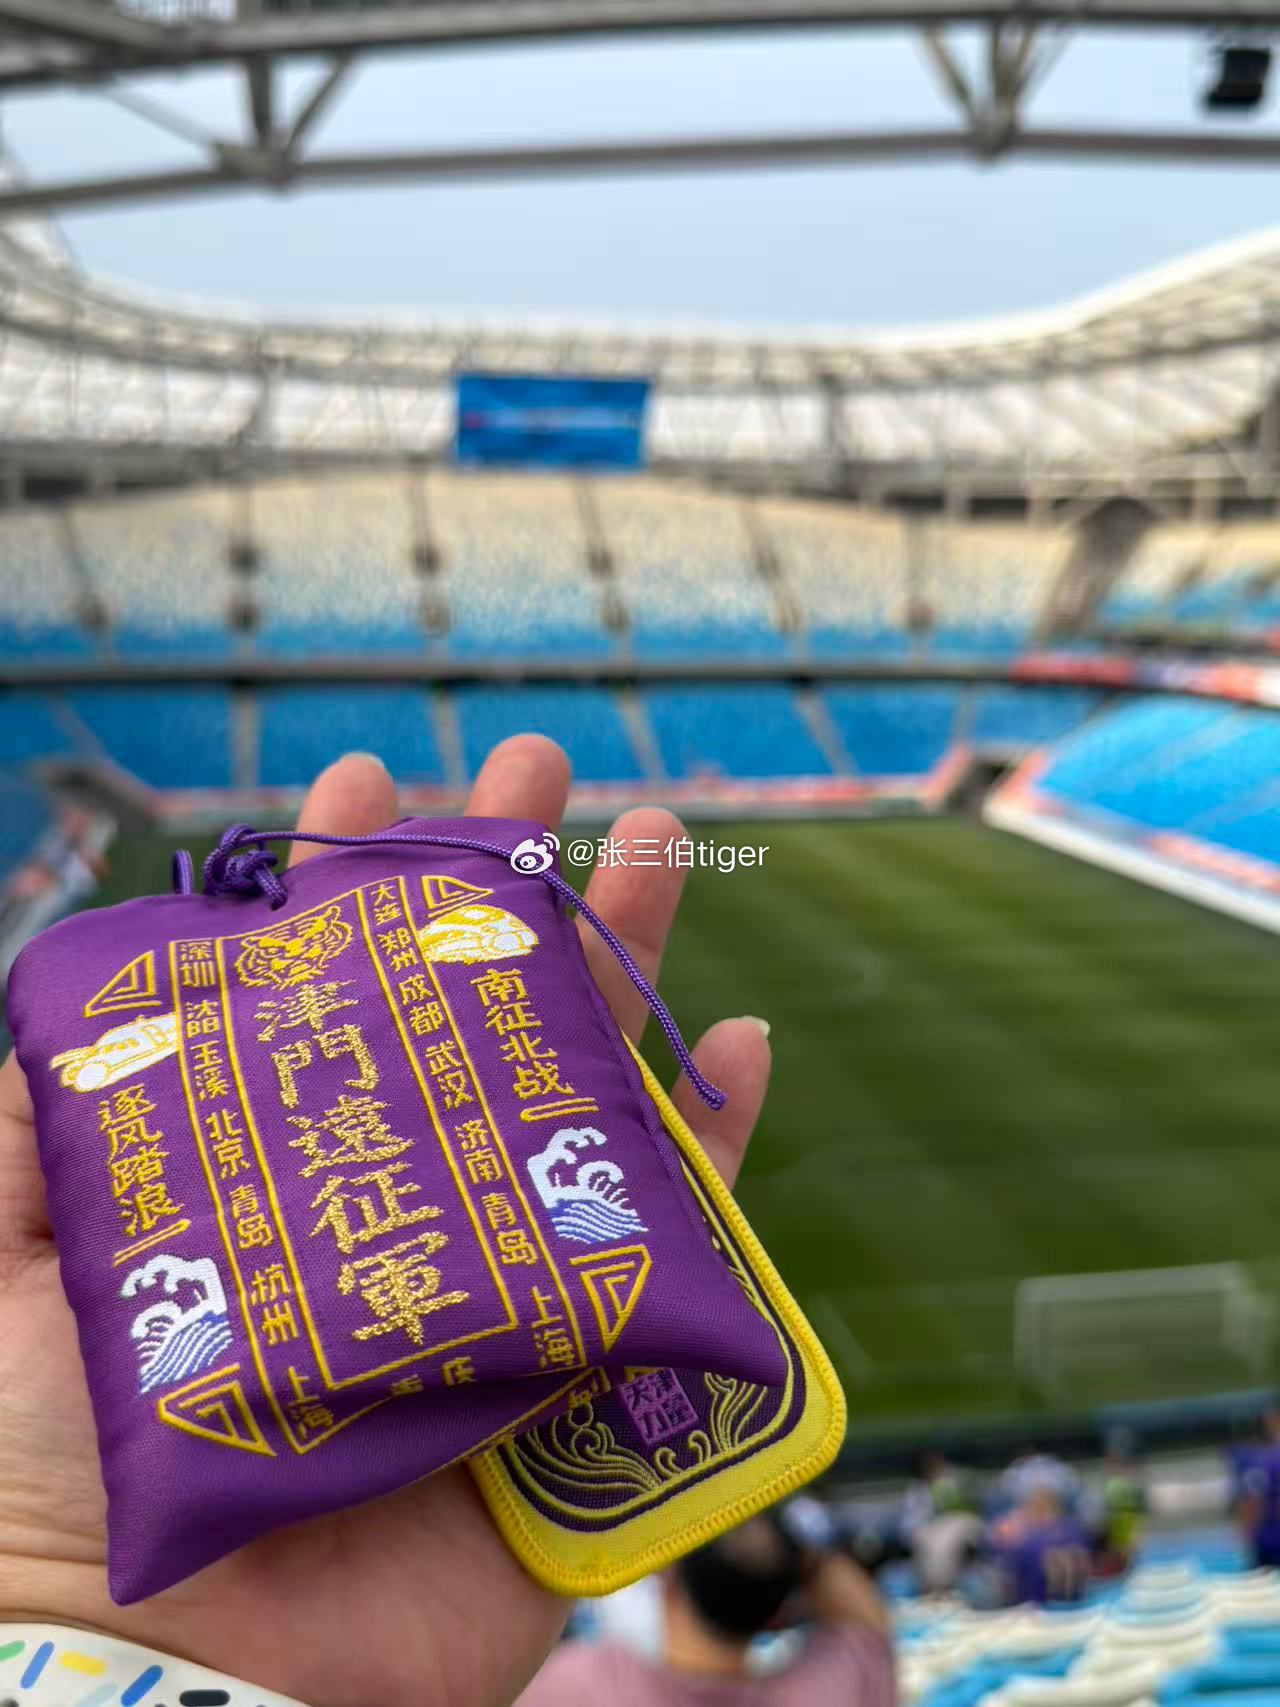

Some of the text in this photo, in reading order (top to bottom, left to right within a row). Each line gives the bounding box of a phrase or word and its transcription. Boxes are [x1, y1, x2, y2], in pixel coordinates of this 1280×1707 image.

[180, 941, 216, 988] 深圳
[470, 968, 575, 1100] 南征北战
[98, 1083, 185, 1237] 逐风踏浪
[205, 1109, 250, 1179] 北京
[377, 927, 418, 972] 郑州
[398, 973, 444, 1036] 成都
[425, 1040, 474, 1110] 武汉
[454, 1118, 503, 1184] 济南
[481, 1192, 537, 1266] 青岛
[531, 1285, 575, 1369] 上海
[229, 1184, 274, 1251] 青岛
[250, 1263, 299, 1345] 杭州
[287, 1366, 335, 1439] 上海
